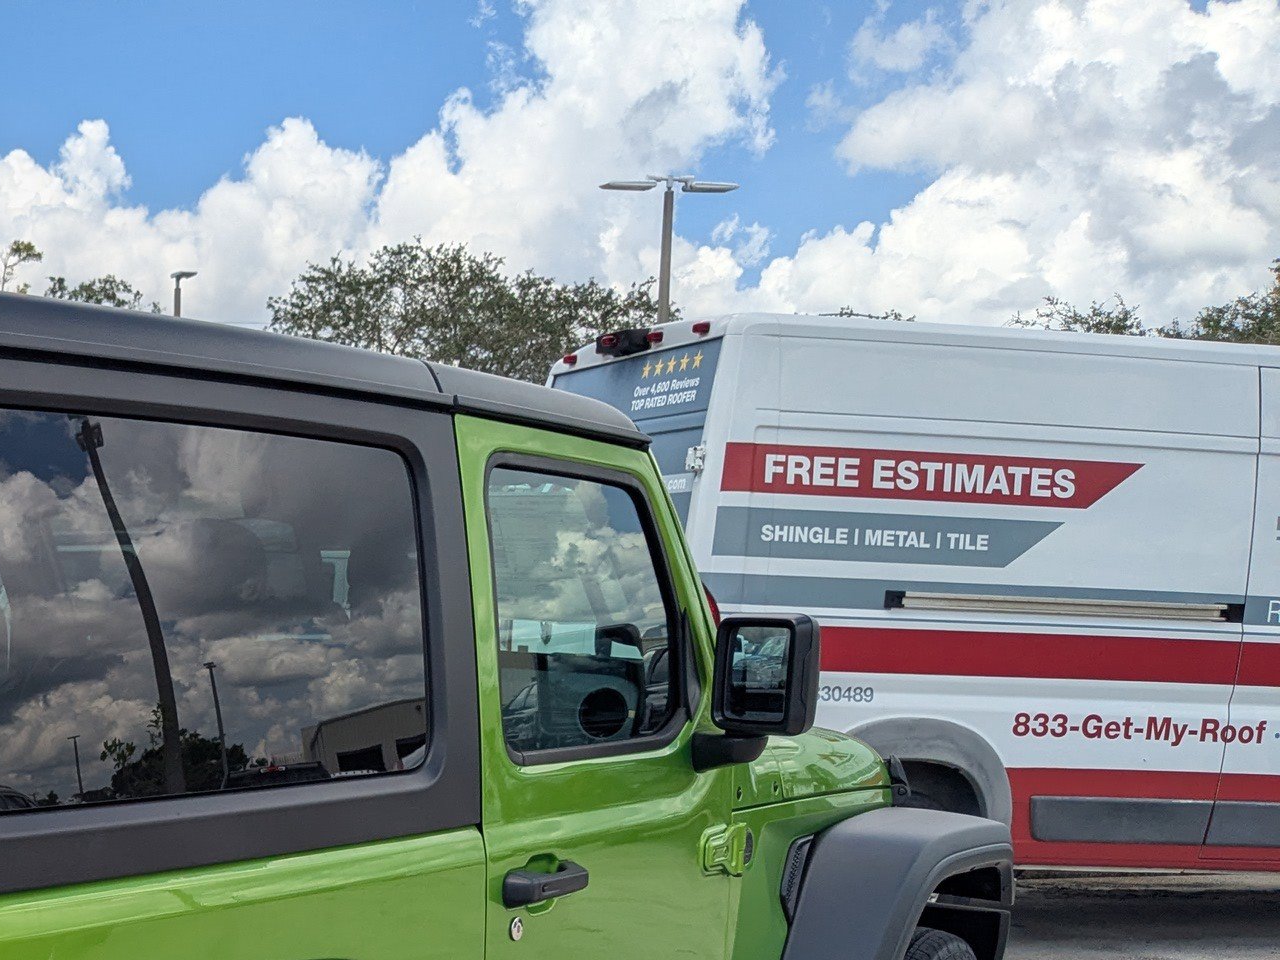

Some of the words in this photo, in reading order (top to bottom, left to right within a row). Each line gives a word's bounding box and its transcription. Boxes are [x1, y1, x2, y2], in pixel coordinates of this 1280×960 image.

[633, 386, 650, 398] Over
[650, 380, 670, 396] 4,600
[670, 377, 700, 391] Reviews
[631, 399, 644, 411] TOP
[644, 394, 667, 410] RATED
[667, 390, 697, 405] ROOFER
[763, 453, 860, 488] FREE
[872, 458, 1076, 499] ESTIMATES
[760, 524, 848, 545] SHINGLE
[864, 528, 930, 549] METAL
[947, 533, 989, 551] TILE
[817, 686, 874, 703] 30489
[1011, 712, 1268, 747] 833-Get-My-Roof
